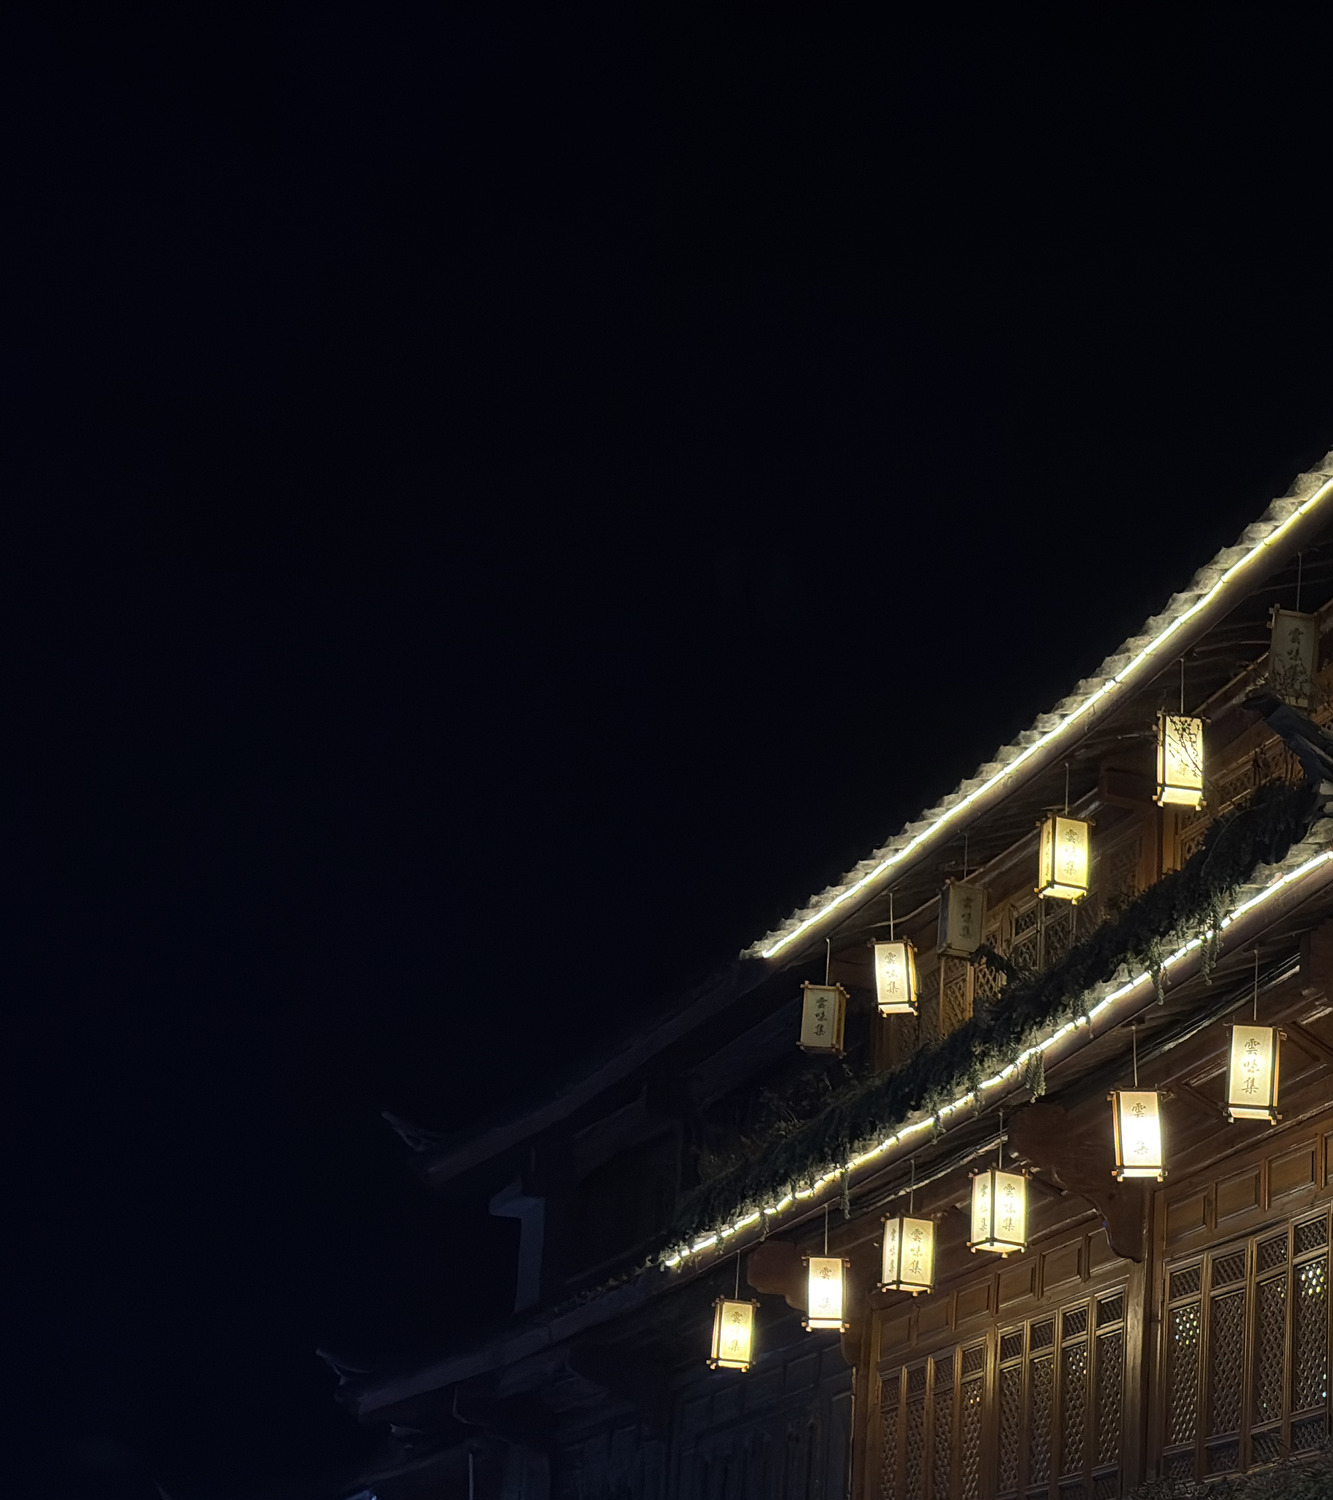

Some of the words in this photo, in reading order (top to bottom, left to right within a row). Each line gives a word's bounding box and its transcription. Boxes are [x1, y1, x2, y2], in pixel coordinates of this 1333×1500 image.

[1131, 1102, 1149, 1156] 雲集
[819, 1266, 832, 1310] 雲集
[731, 1311, 743, 1353] 雲集
